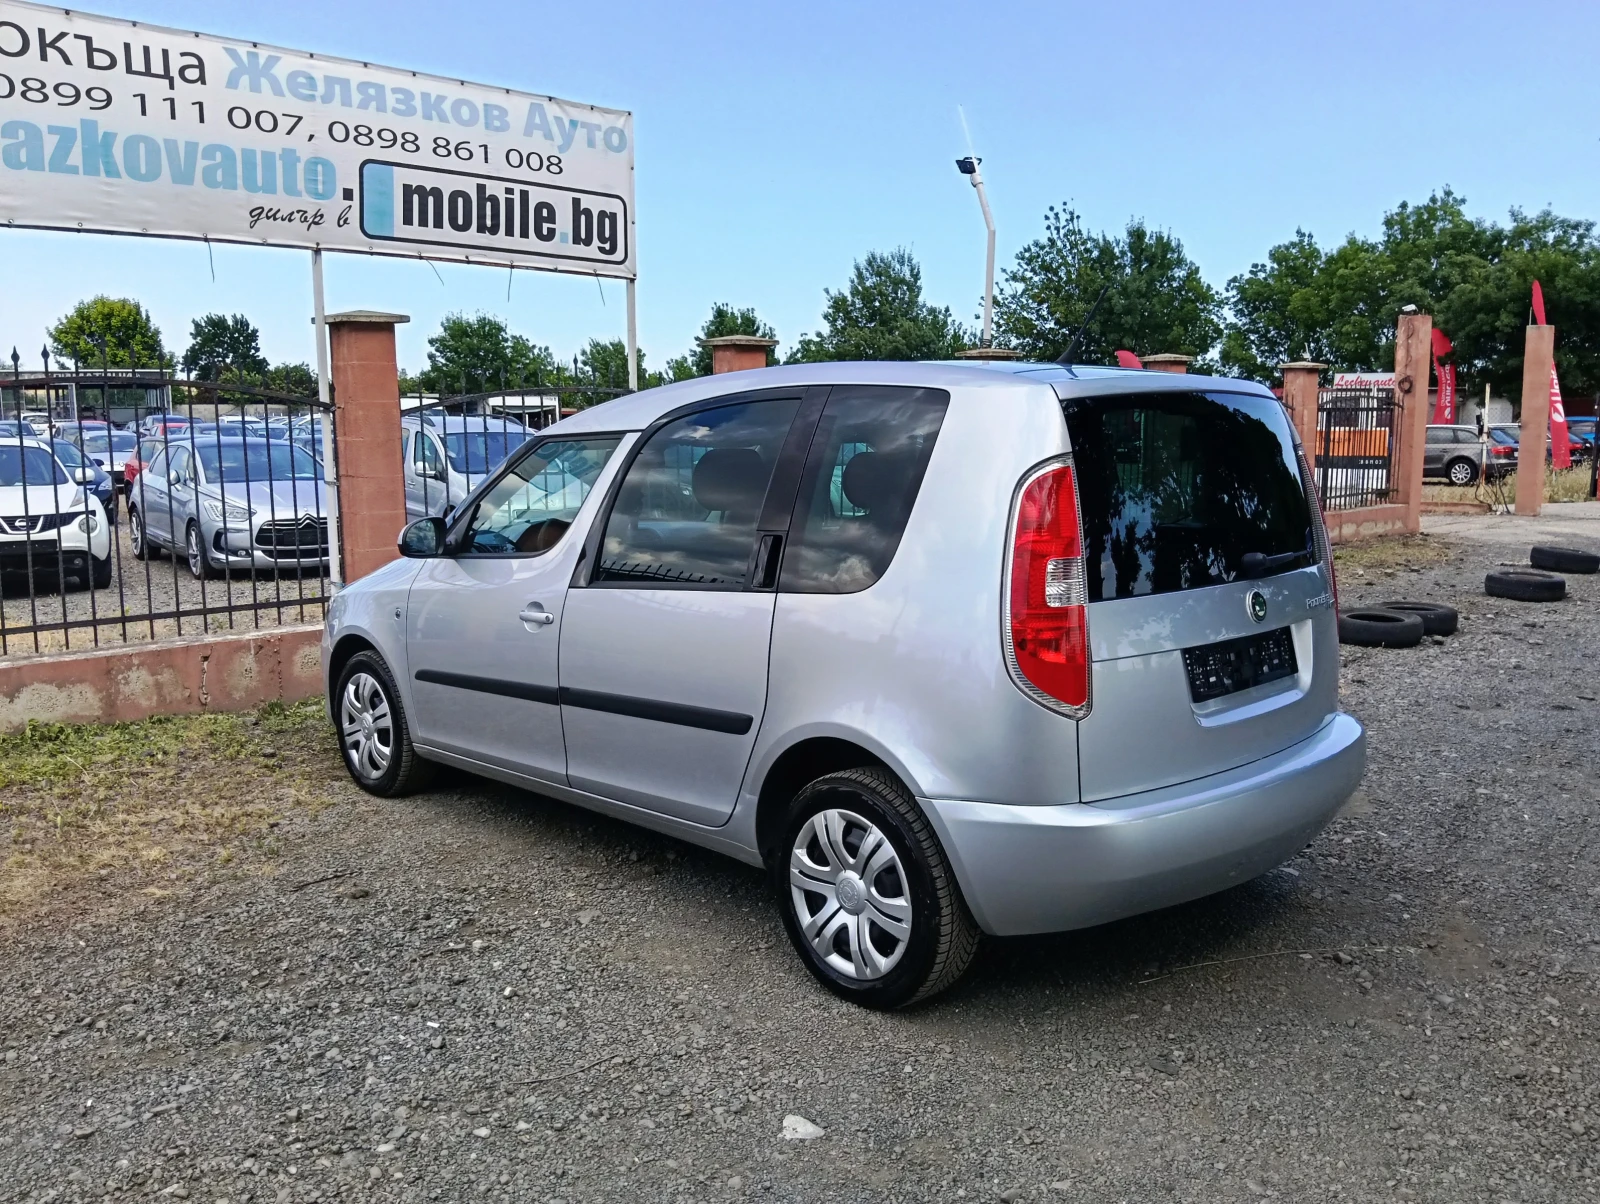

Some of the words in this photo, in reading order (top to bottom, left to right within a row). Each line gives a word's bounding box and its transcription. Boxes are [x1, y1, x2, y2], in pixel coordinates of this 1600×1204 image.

[133, 93, 205, 124] 111
[328, 120, 421, 153] 0898
[432, 136, 489, 164] 861
[505, 148, 564, 175] 008
[222, 46, 511, 133] Желязков
[523, 101, 628, 154] Ауто
[249, 205, 326, 231] дилър
[337, 205, 353, 226] в
[402, 183, 618, 256] mobile.bg
